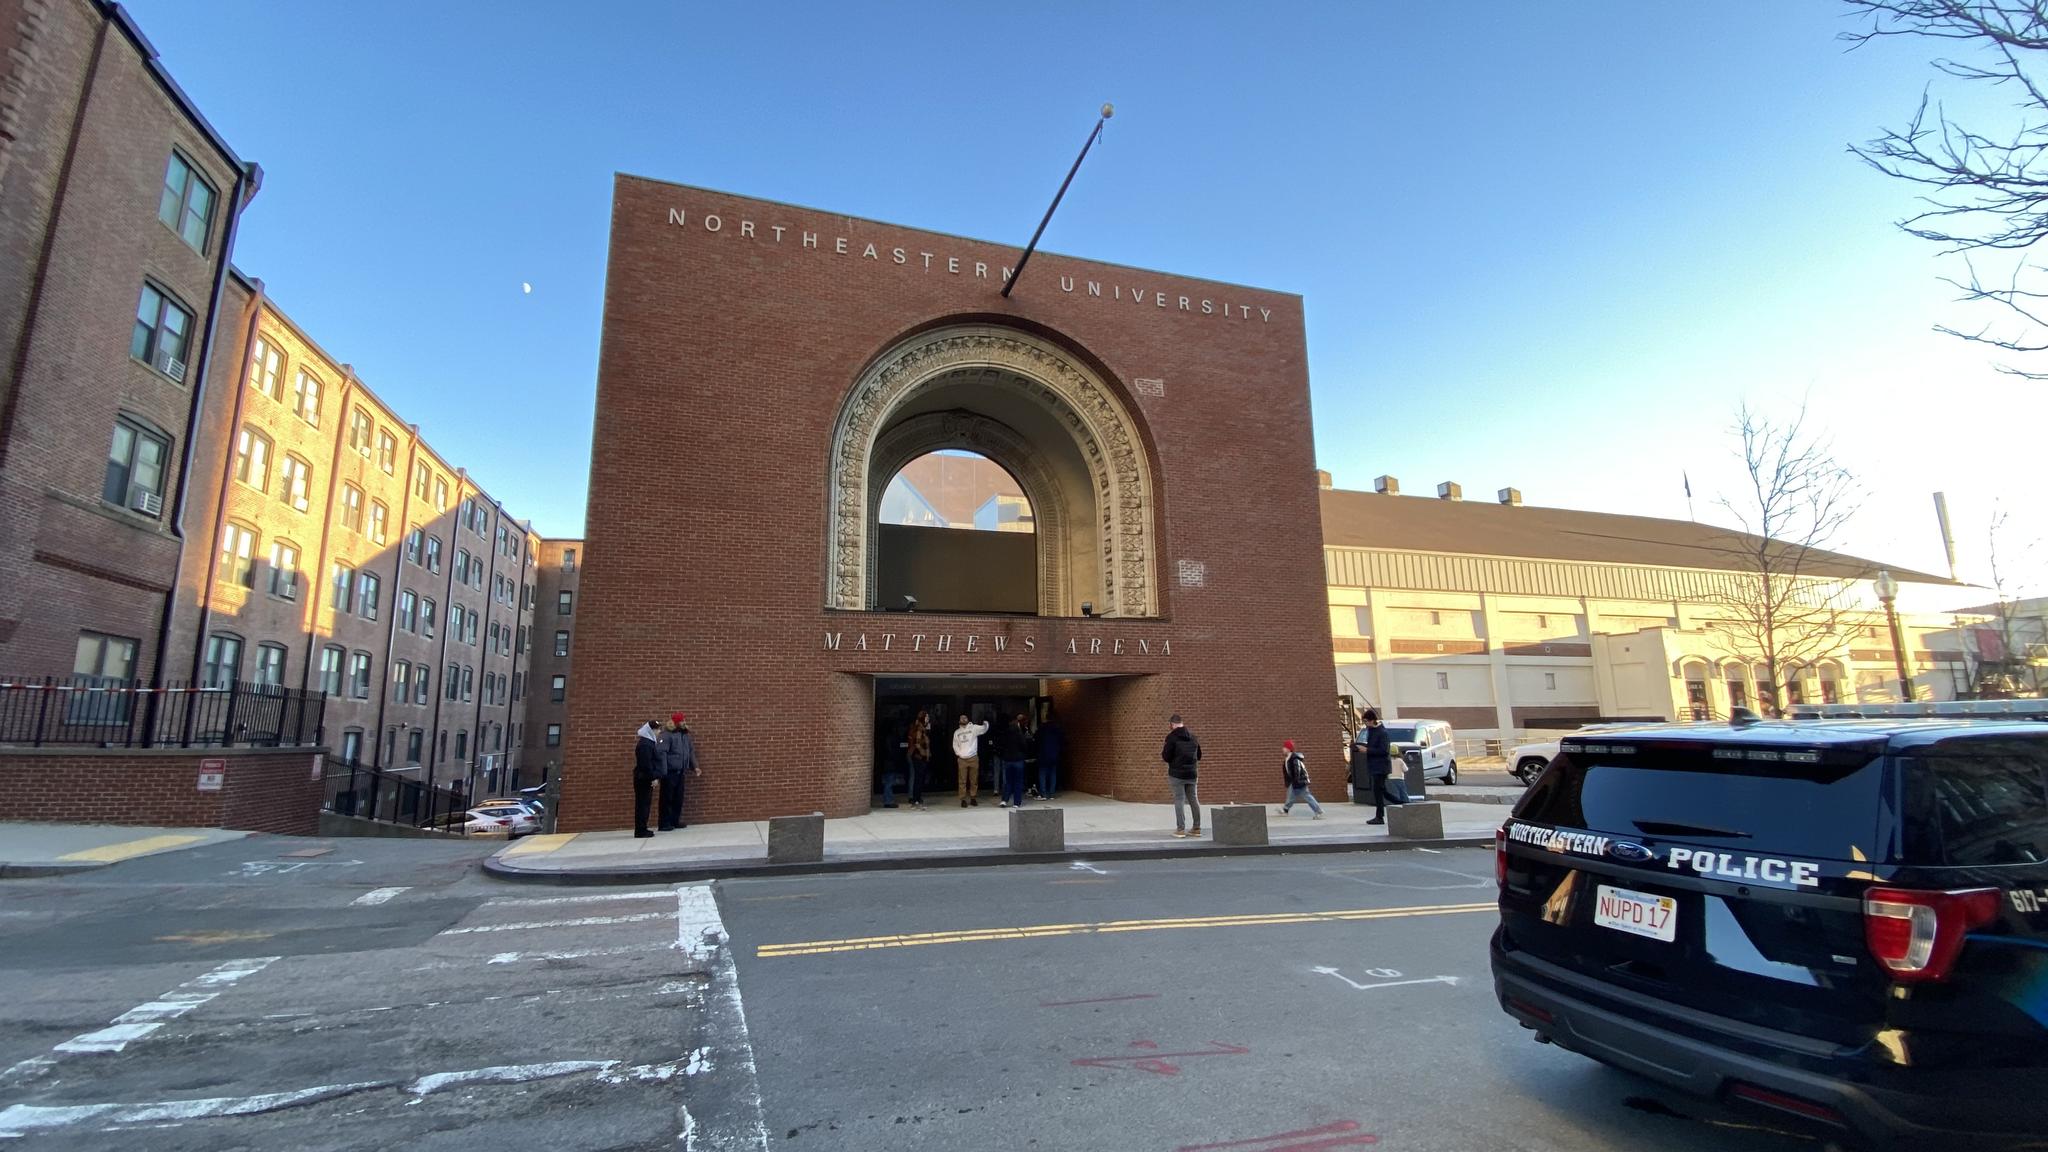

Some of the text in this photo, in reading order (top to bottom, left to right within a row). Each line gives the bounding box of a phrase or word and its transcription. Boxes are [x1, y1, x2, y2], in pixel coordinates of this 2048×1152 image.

[668, 207, 1271, 323] NORTHEASTERN UNIVERSITY
[823, 632, 1171, 656] MATTHEWS ARENA
[1509, 822, 1819, 887] NORTHEASTERN POLICE
[1600, 896, 1643, 923] NUPD
[1647, 907, 1671, 929] 17
[2009, 888, 2048, 913] 617-
